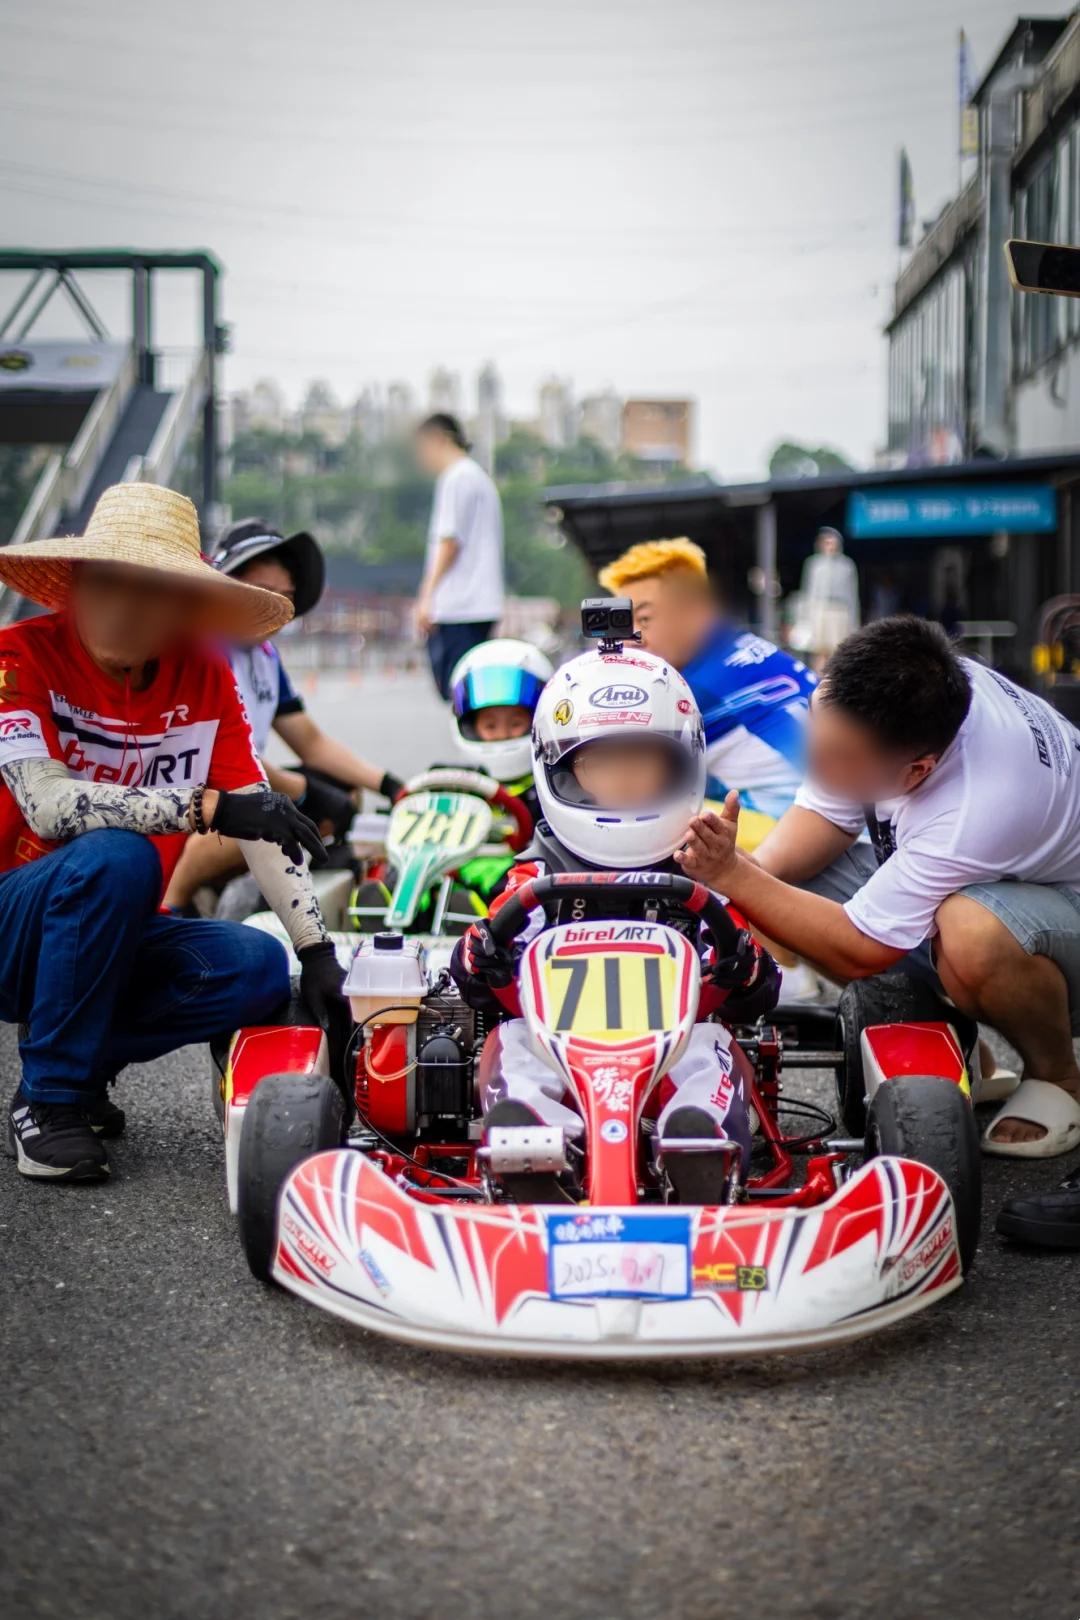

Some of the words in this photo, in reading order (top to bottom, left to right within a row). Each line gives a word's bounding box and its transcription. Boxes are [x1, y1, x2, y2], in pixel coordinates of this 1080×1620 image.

[594, 687, 641, 703] Arai
[17, 732, 41, 741] Racing
[565, 927, 658, 942] birelART
[551, 957, 665, 1031] 711
